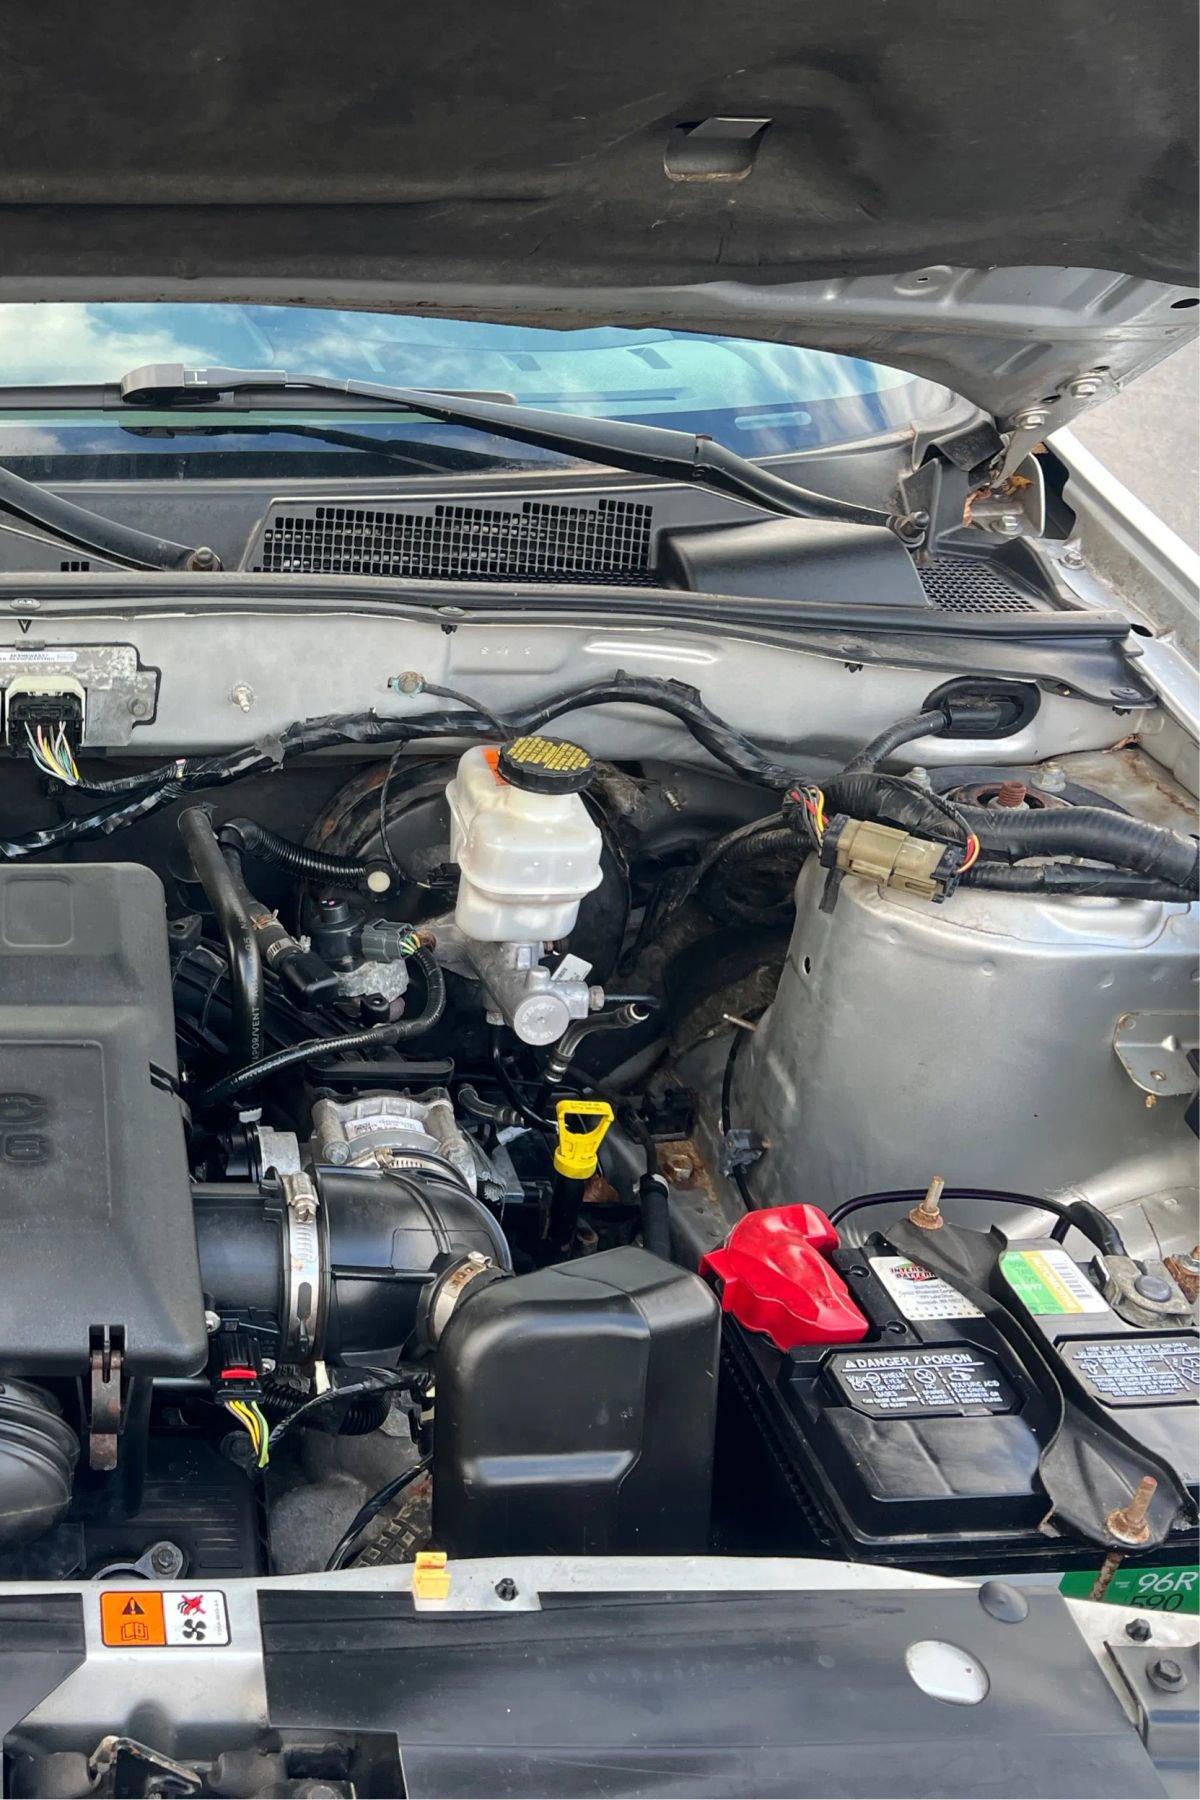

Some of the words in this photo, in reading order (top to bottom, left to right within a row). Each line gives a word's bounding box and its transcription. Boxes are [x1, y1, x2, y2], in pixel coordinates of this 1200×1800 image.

[856, 1356, 912, 1369] DANGER
[922, 1354, 973, 1365] POISON
[1137, 1571, 1199, 1594] 96R
